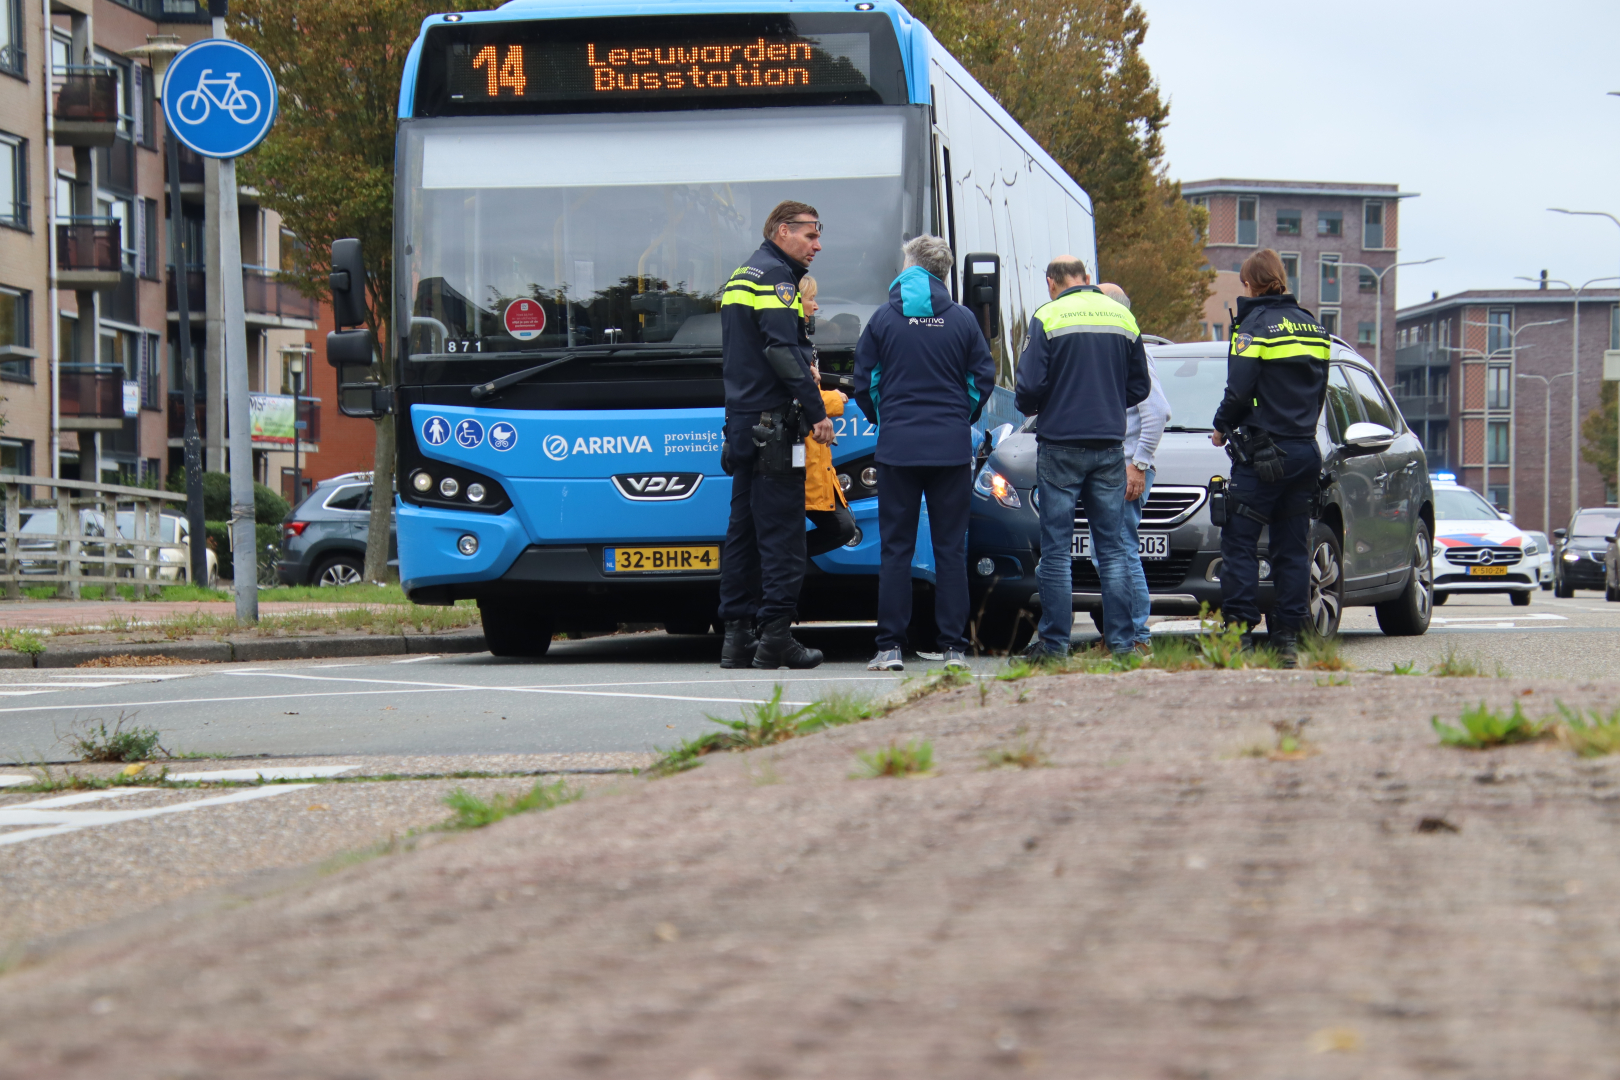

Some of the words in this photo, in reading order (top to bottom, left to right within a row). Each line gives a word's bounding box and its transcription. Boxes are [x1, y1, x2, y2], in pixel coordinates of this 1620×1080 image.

[588, 37, 811, 66] Leeuwarden
[472, 45, 527, 96] 14
[594, 63, 809, 91] Busstation
[1060, 311, 1087, 319] SERVICE
[571, 435, 653, 455] ARRIVA
[664, 430, 718, 445] provinsje
[664, 442, 719, 456] provincie
[626, 476, 686, 493] VDL
[620, 550, 712, 569] 32-BHR-4
